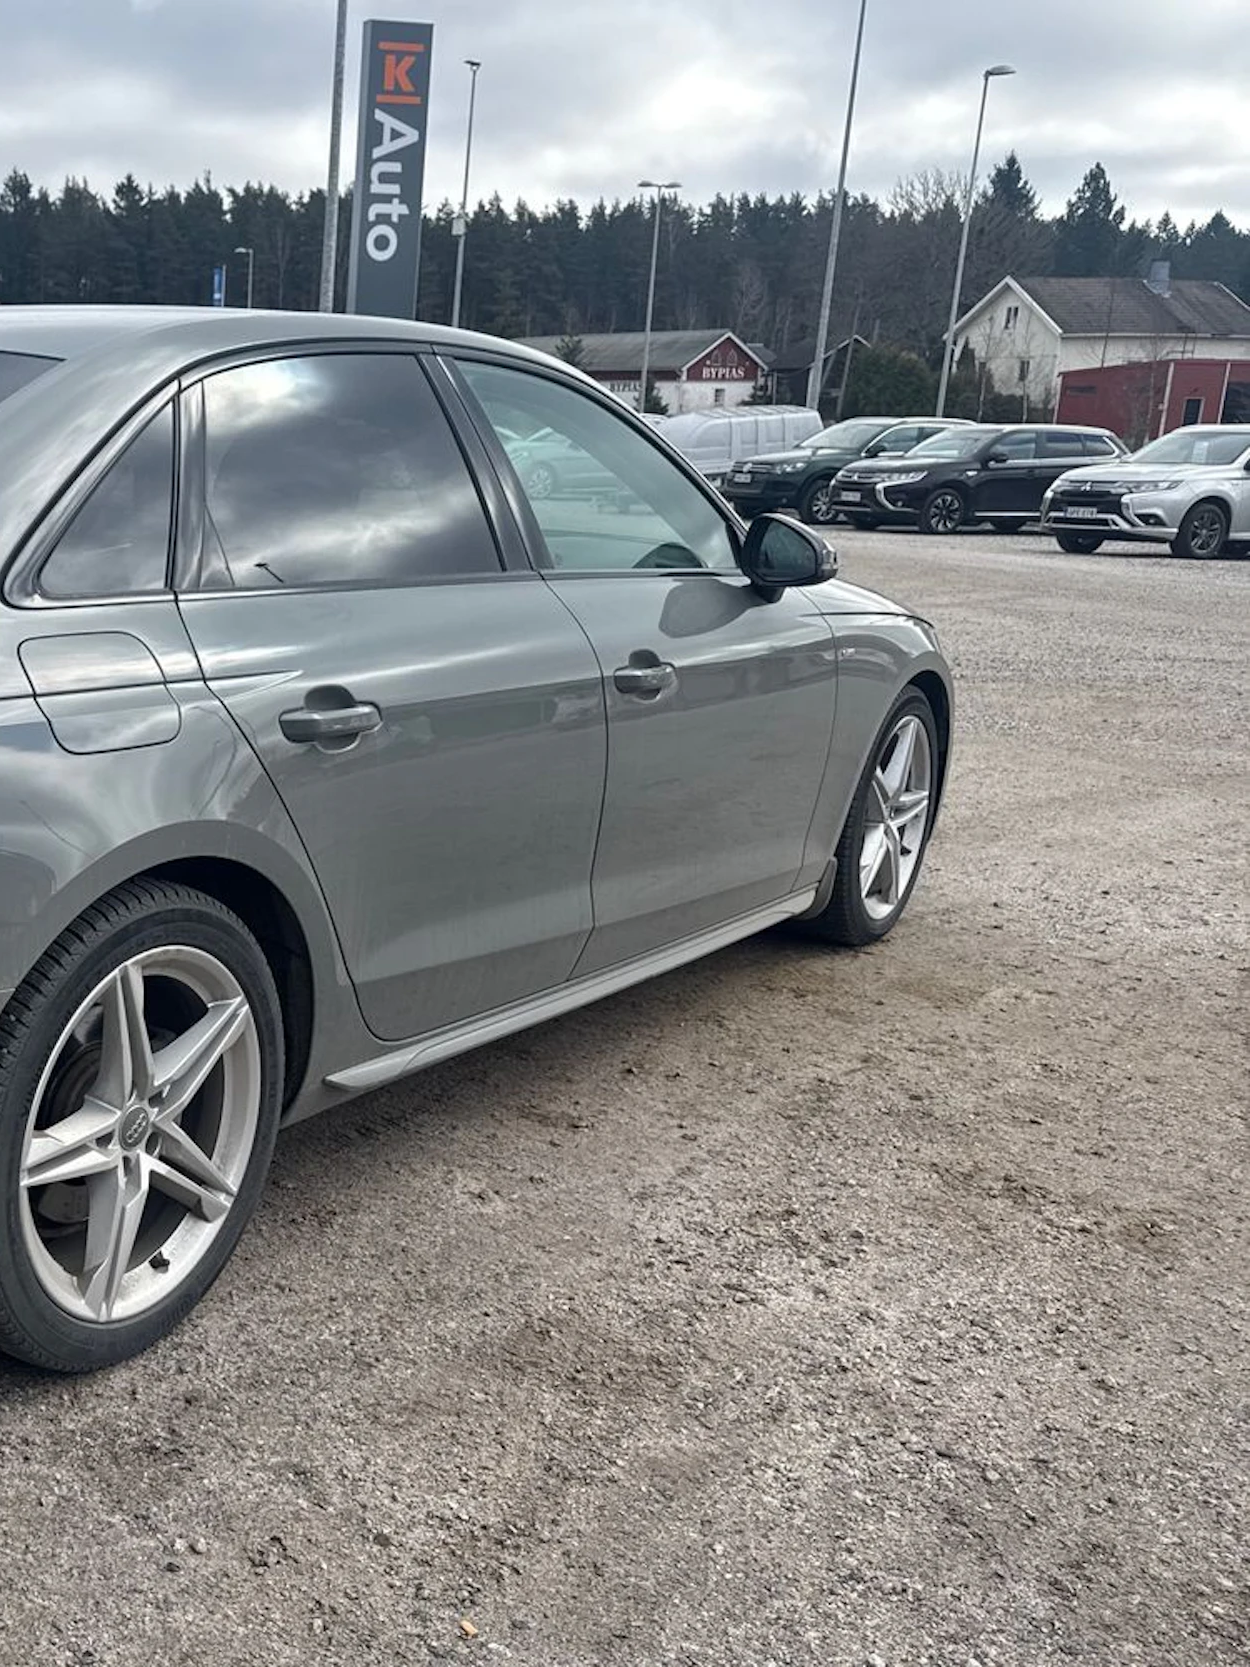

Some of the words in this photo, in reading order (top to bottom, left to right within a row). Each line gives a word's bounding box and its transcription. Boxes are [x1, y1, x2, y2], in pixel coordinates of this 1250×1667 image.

[382, 54, 415, 92] K
[366, 108, 419, 261] Auto
[702, 367, 745, 379] BYPIAS
